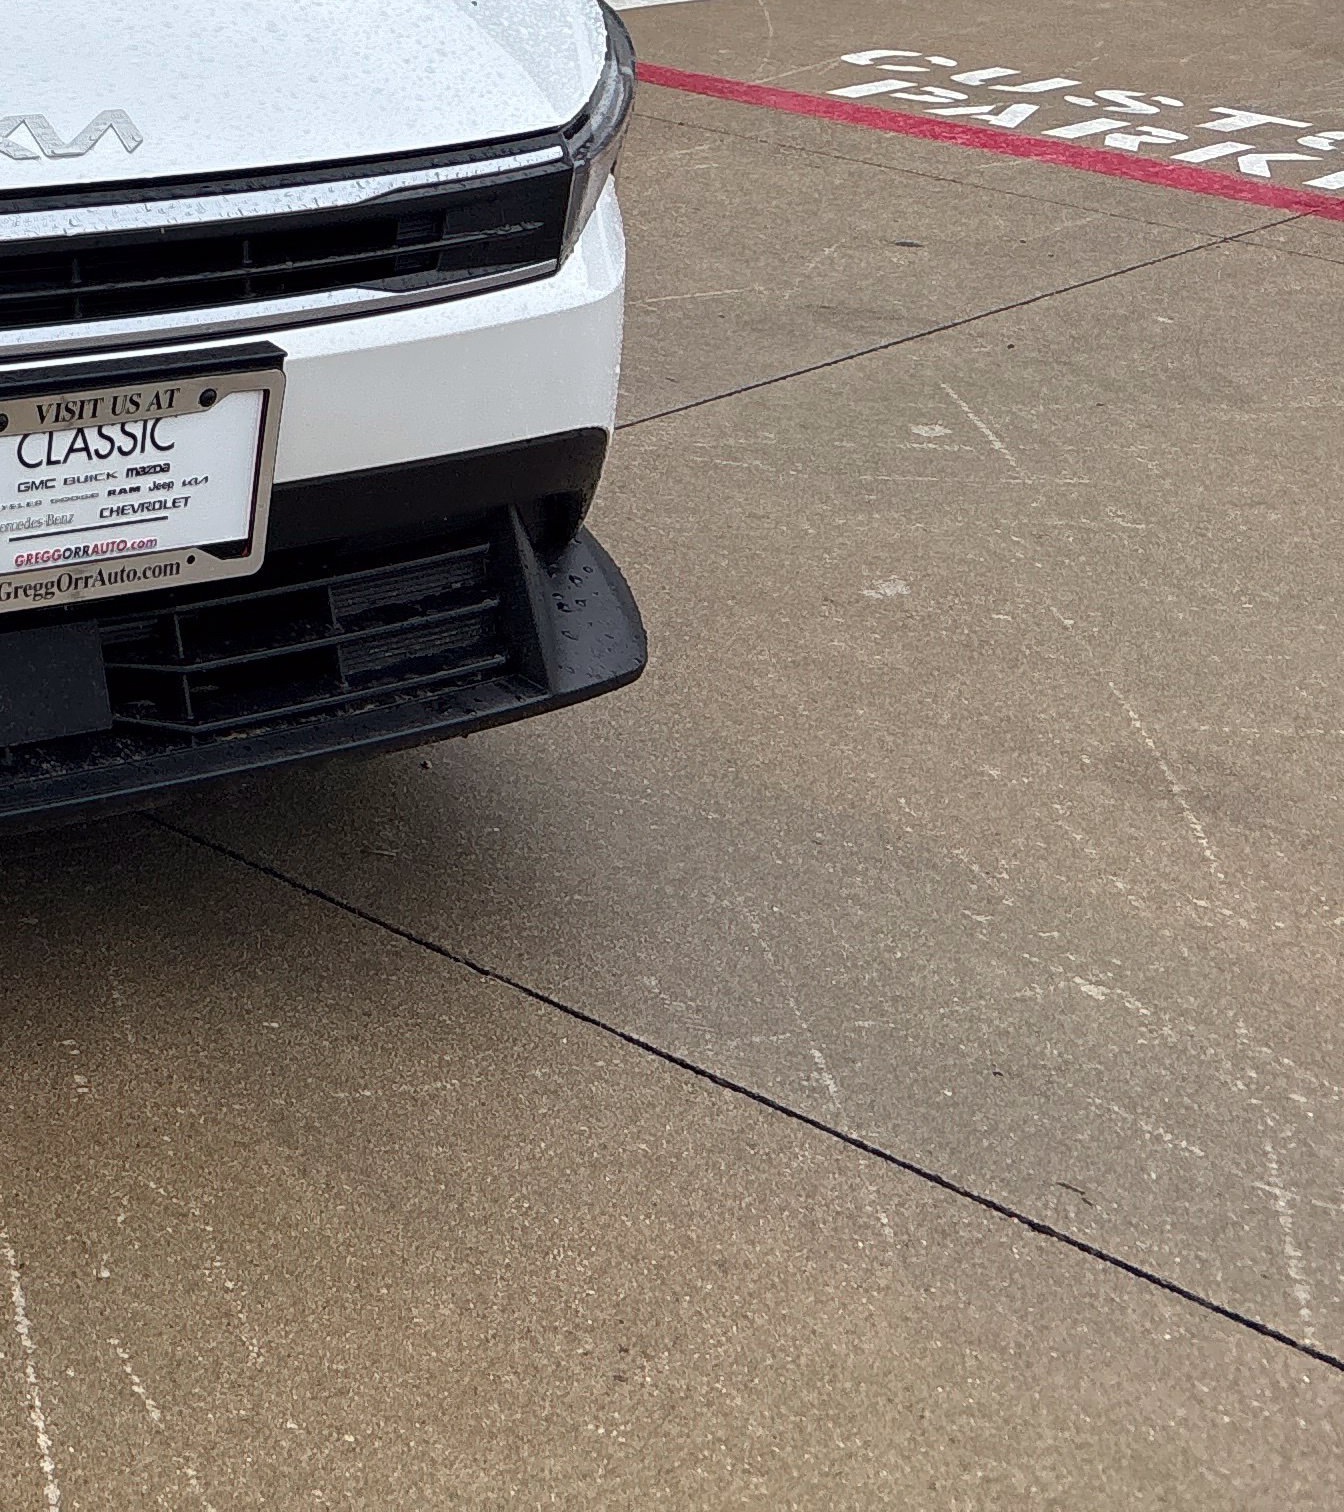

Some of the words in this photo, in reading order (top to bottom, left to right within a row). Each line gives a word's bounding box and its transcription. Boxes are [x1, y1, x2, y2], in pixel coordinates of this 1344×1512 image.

[35, 397, 104, 425] VISIT
[112, 393, 141, 416] US
[146, 388, 181, 413] AT
[17, 416, 175, 469] CLASSIC
[17, 478, 57, 494] GMC
[63, 471, 118, 486] BUICK
[107, 485, 141, 498] RAM
[148, 479, 174, 494] Jeep
[99, 496, 192, 519] CHEVROLET
[14, 537, 158, 568] GREGGORRAUTO.com
